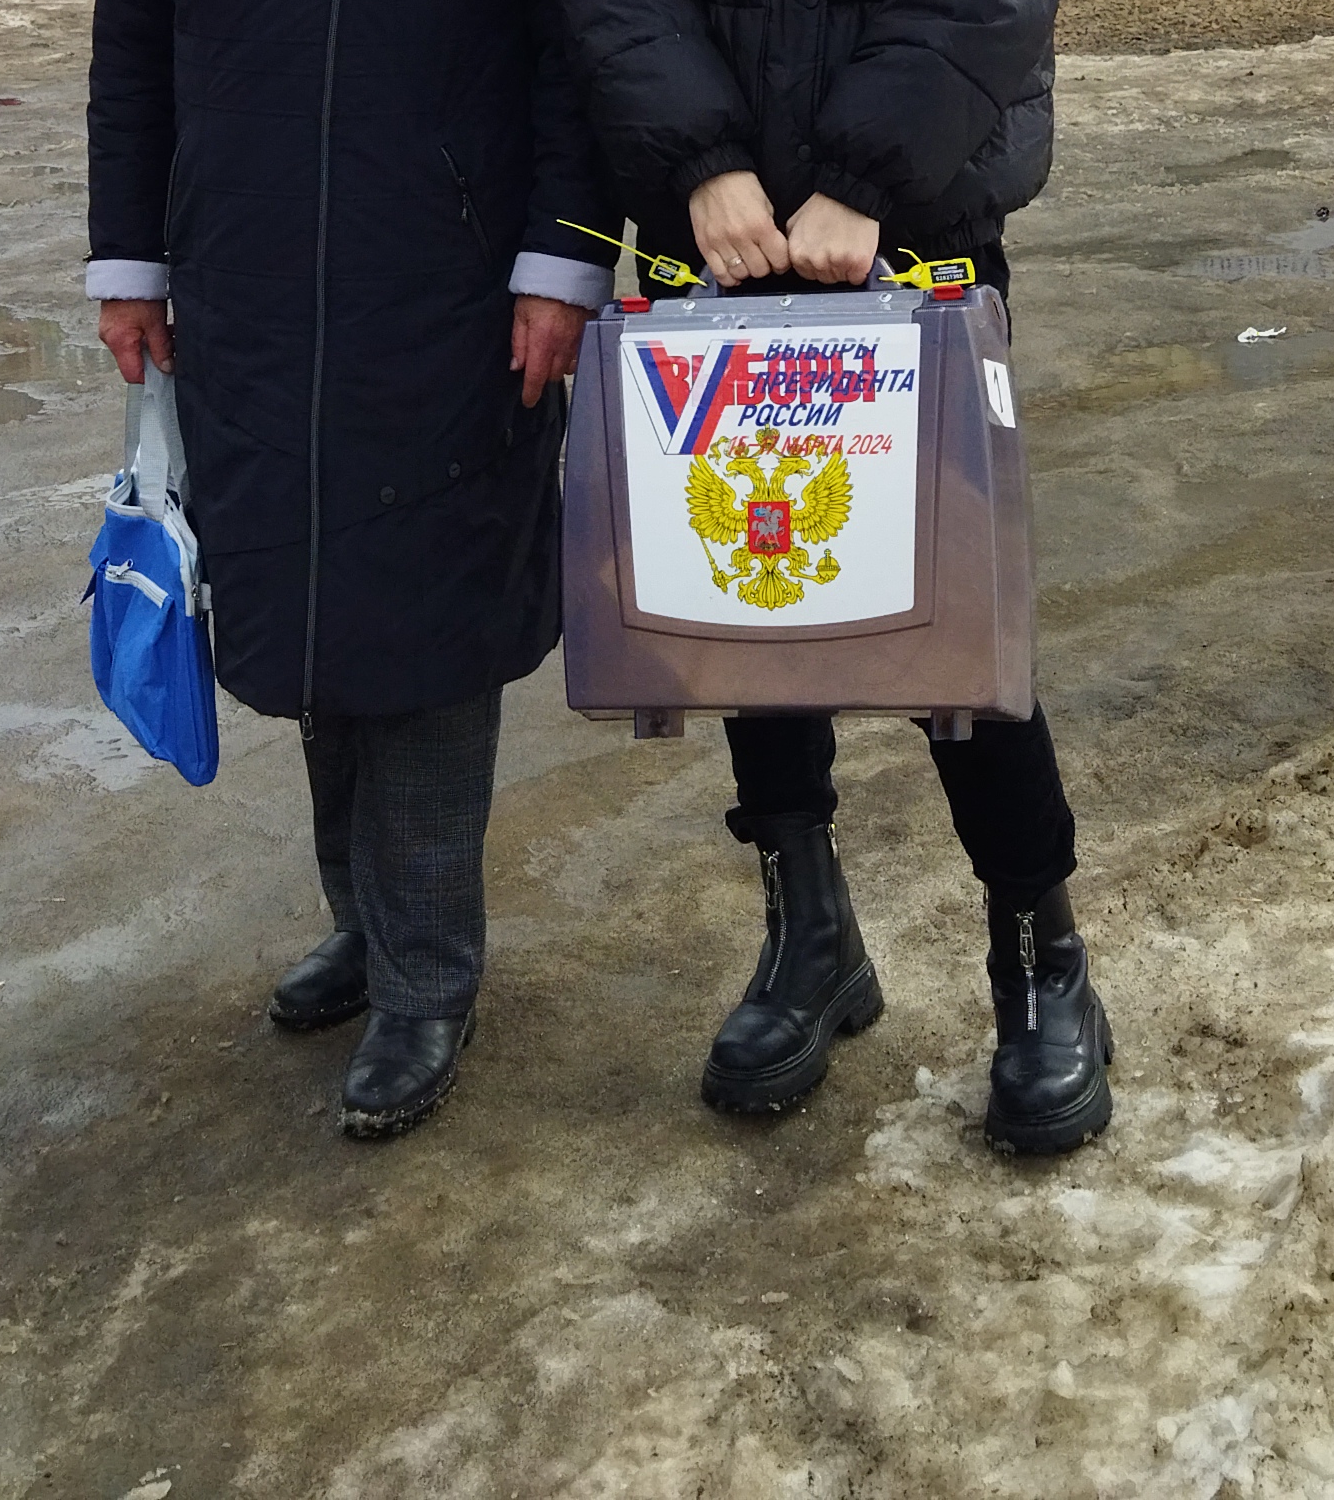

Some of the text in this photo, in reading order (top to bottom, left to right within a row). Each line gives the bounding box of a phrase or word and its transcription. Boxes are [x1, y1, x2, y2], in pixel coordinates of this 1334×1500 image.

[765, 337, 880, 361] ВЫБОРЫ
[751, 368, 916, 396] ПРЕЗИДЕНТА
[737, 403, 844, 427] РОССИИ
[847, 434, 892, 455] 2024
